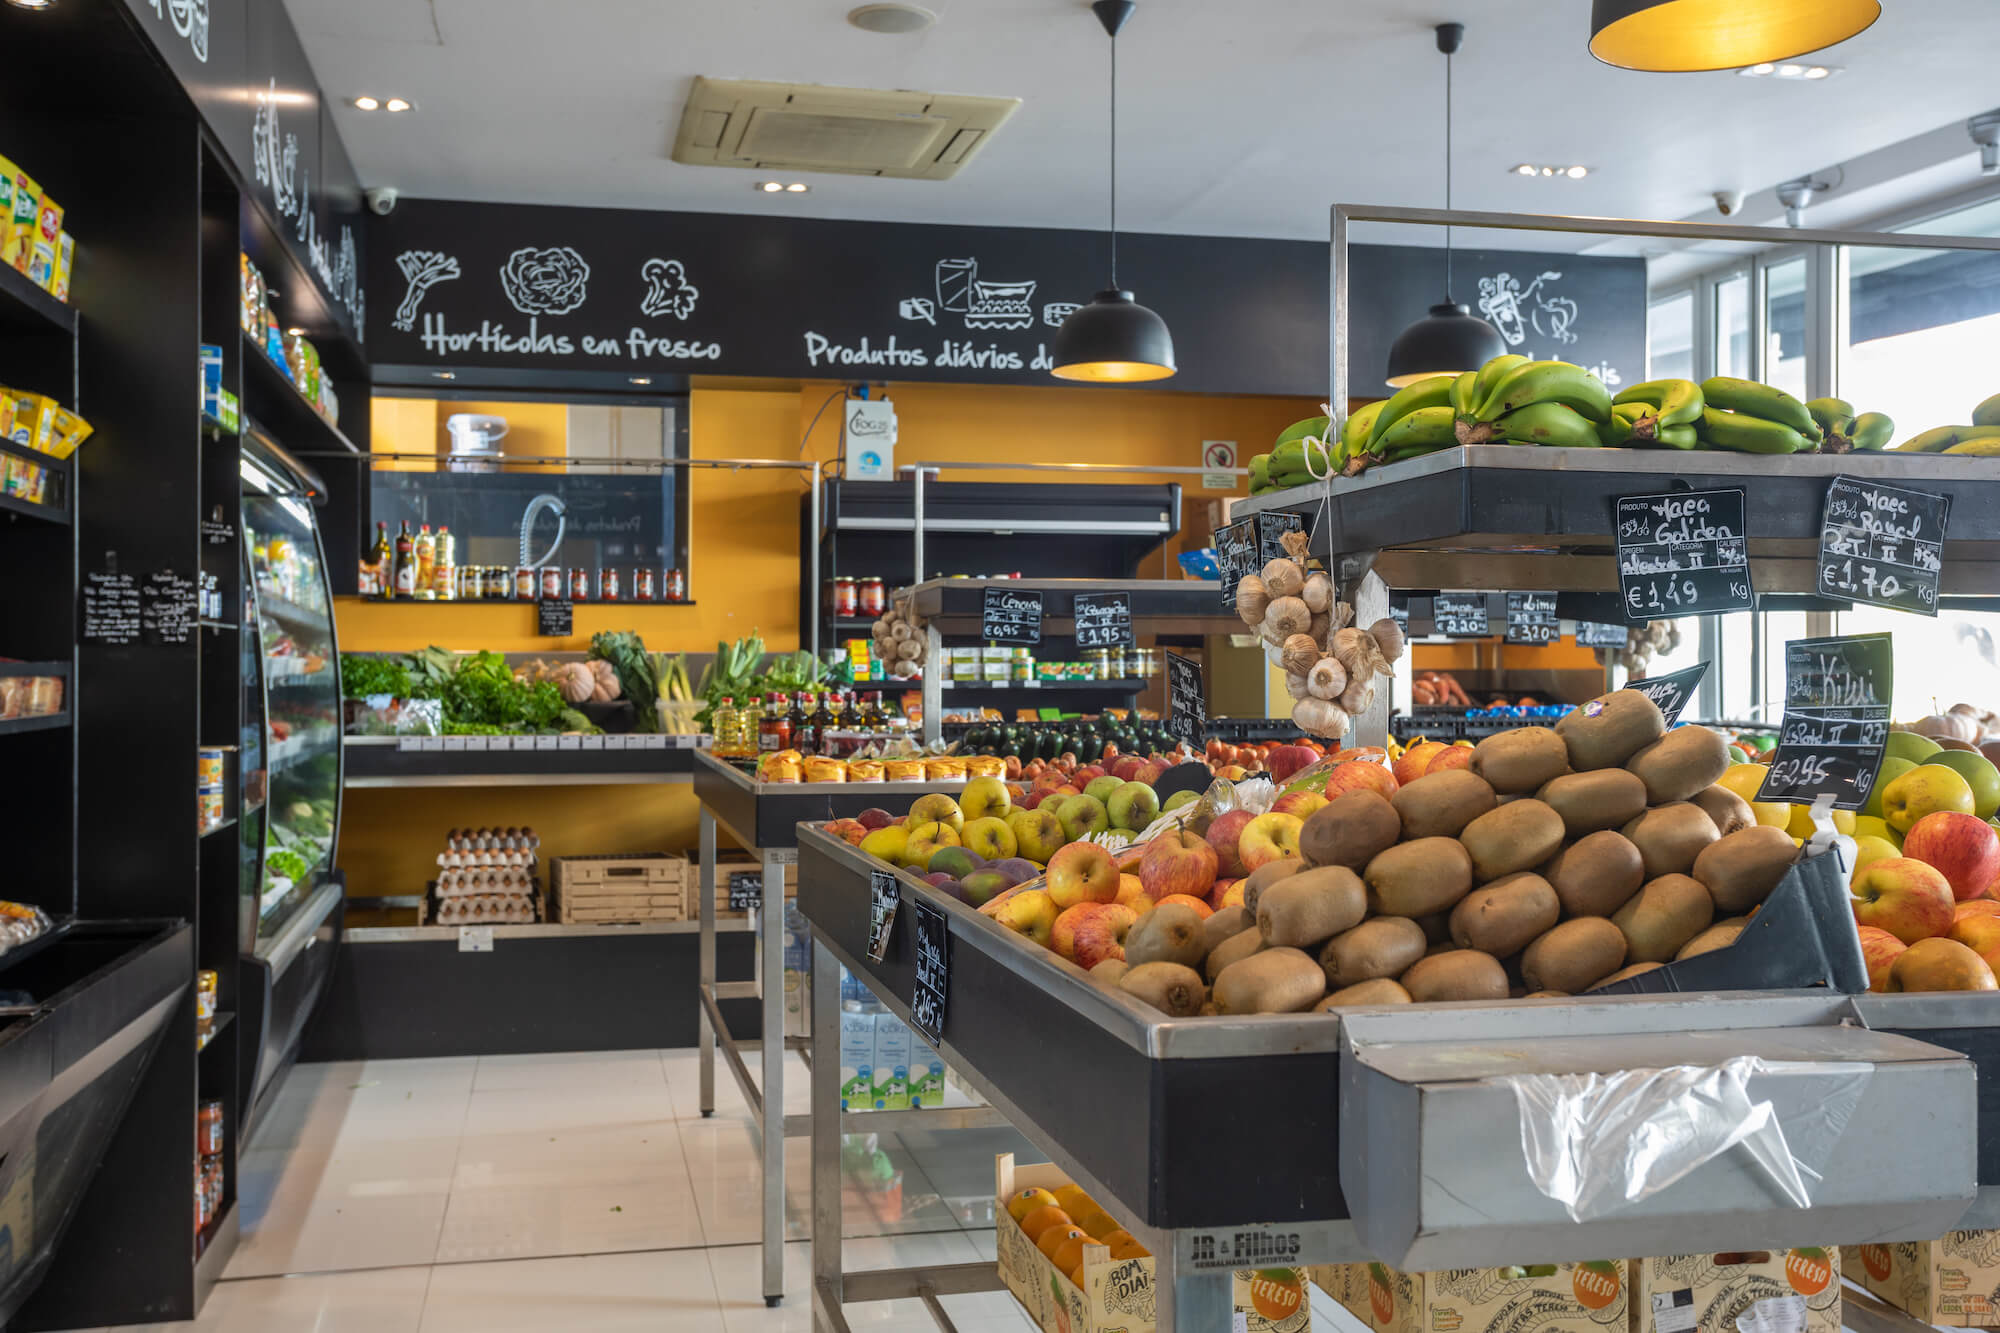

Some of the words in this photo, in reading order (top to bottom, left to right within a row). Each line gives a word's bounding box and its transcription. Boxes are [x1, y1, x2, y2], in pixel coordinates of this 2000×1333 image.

[421, 312, 574, 356] Hortícolas
[582, 335, 621, 355] em
[626, 327, 721, 359] fresco
[804, 331, 928, 366] Produtos
[935, 339, 1024, 369] diários
[1620, 502, 1648, 511] PRODUTO
[1688, 552, 1704, 569] II
[1628, 586, 1643, 608] €
[1649, 573, 1698, 612] 1,49
[1730, 582, 1747, 600] Kg
[1823, 564, 1838, 586] €
[1838, 559, 1899, 597] 1,70
[1918, 584, 1933, 604] Kg
[993, 624, 1019, 638] 0,95
[1088, 627, 1119, 644] 1,95
[1770, 761, 1787, 787] €
[1782, 755, 1837, 785] 2,95
[1853, 768, 1871, 793] Kg
[1192, 1235, 1215, 1260] JR
[1234, 1231, 1300, 1257] Filhos
[1111, 1259, 1143, 1287] BOM
[1575, 1269, 1614, 1297] TERESO
[1787, 1255, 1827, 1283] TERESO
[1119, 1272, 1149, 1299] DIA!
[1253, 1279, 1297, 1307] TERESO
